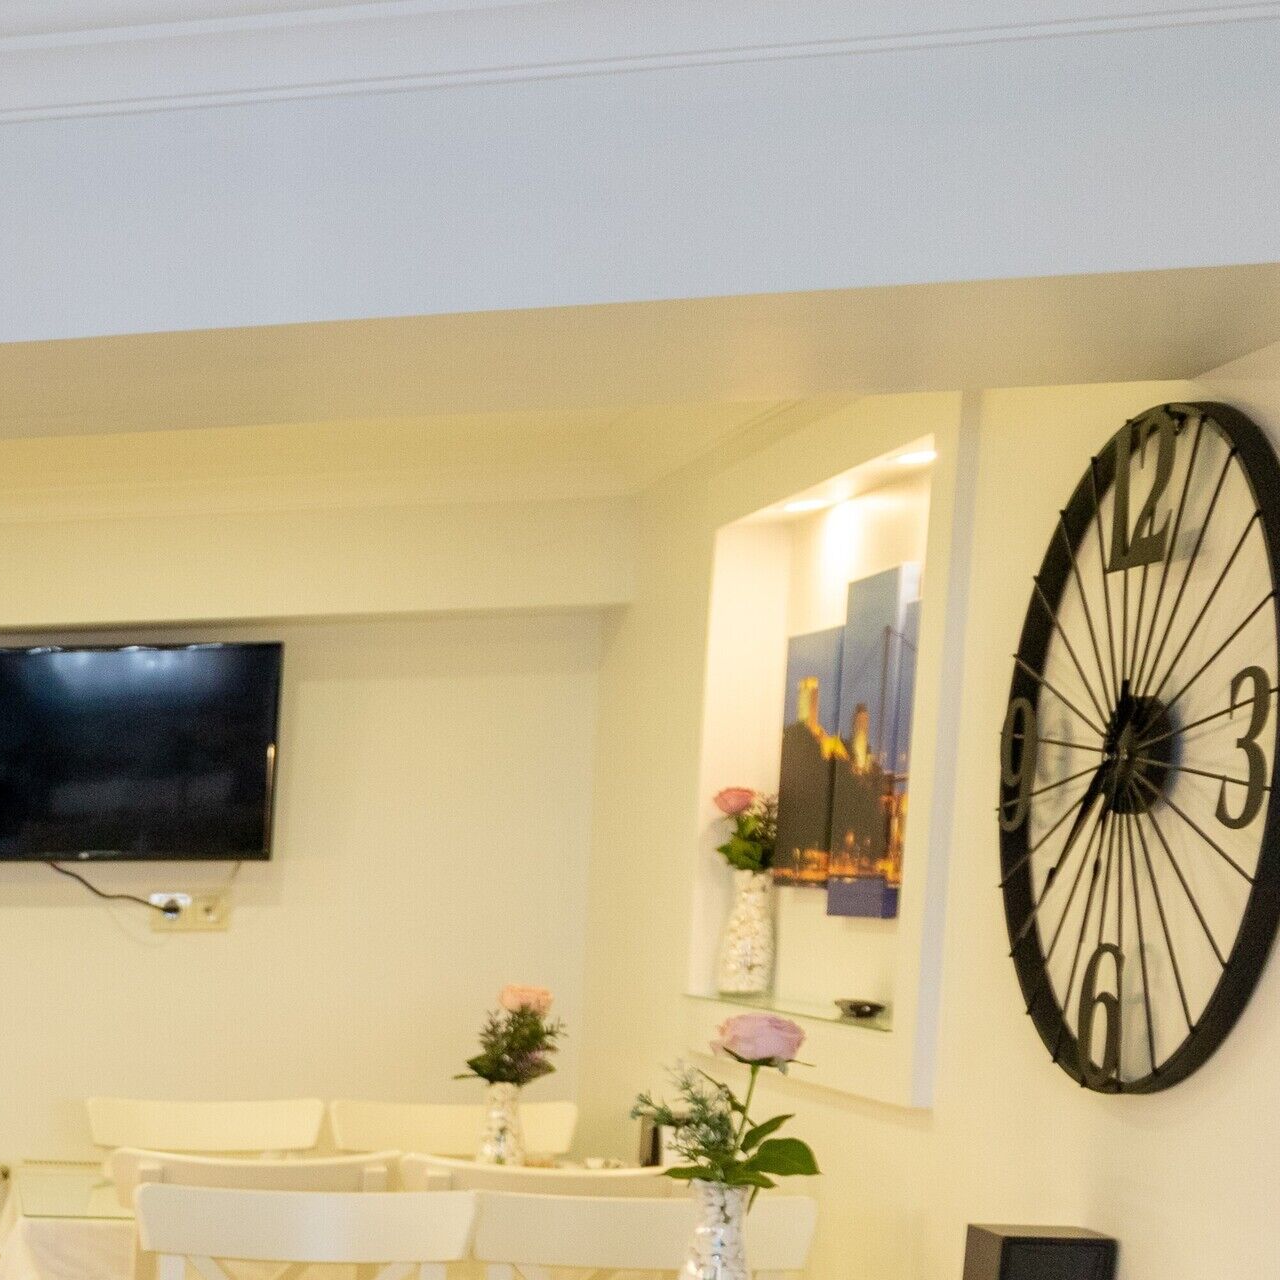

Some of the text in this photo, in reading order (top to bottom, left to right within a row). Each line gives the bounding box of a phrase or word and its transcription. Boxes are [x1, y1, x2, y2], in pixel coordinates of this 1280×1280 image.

[1104, 408, 1178, 574] 12
[999, 697, 1039, 832] 9
[1215, 665, 1271, 829] 3
[1078, 943, 1126, 1088] 6
